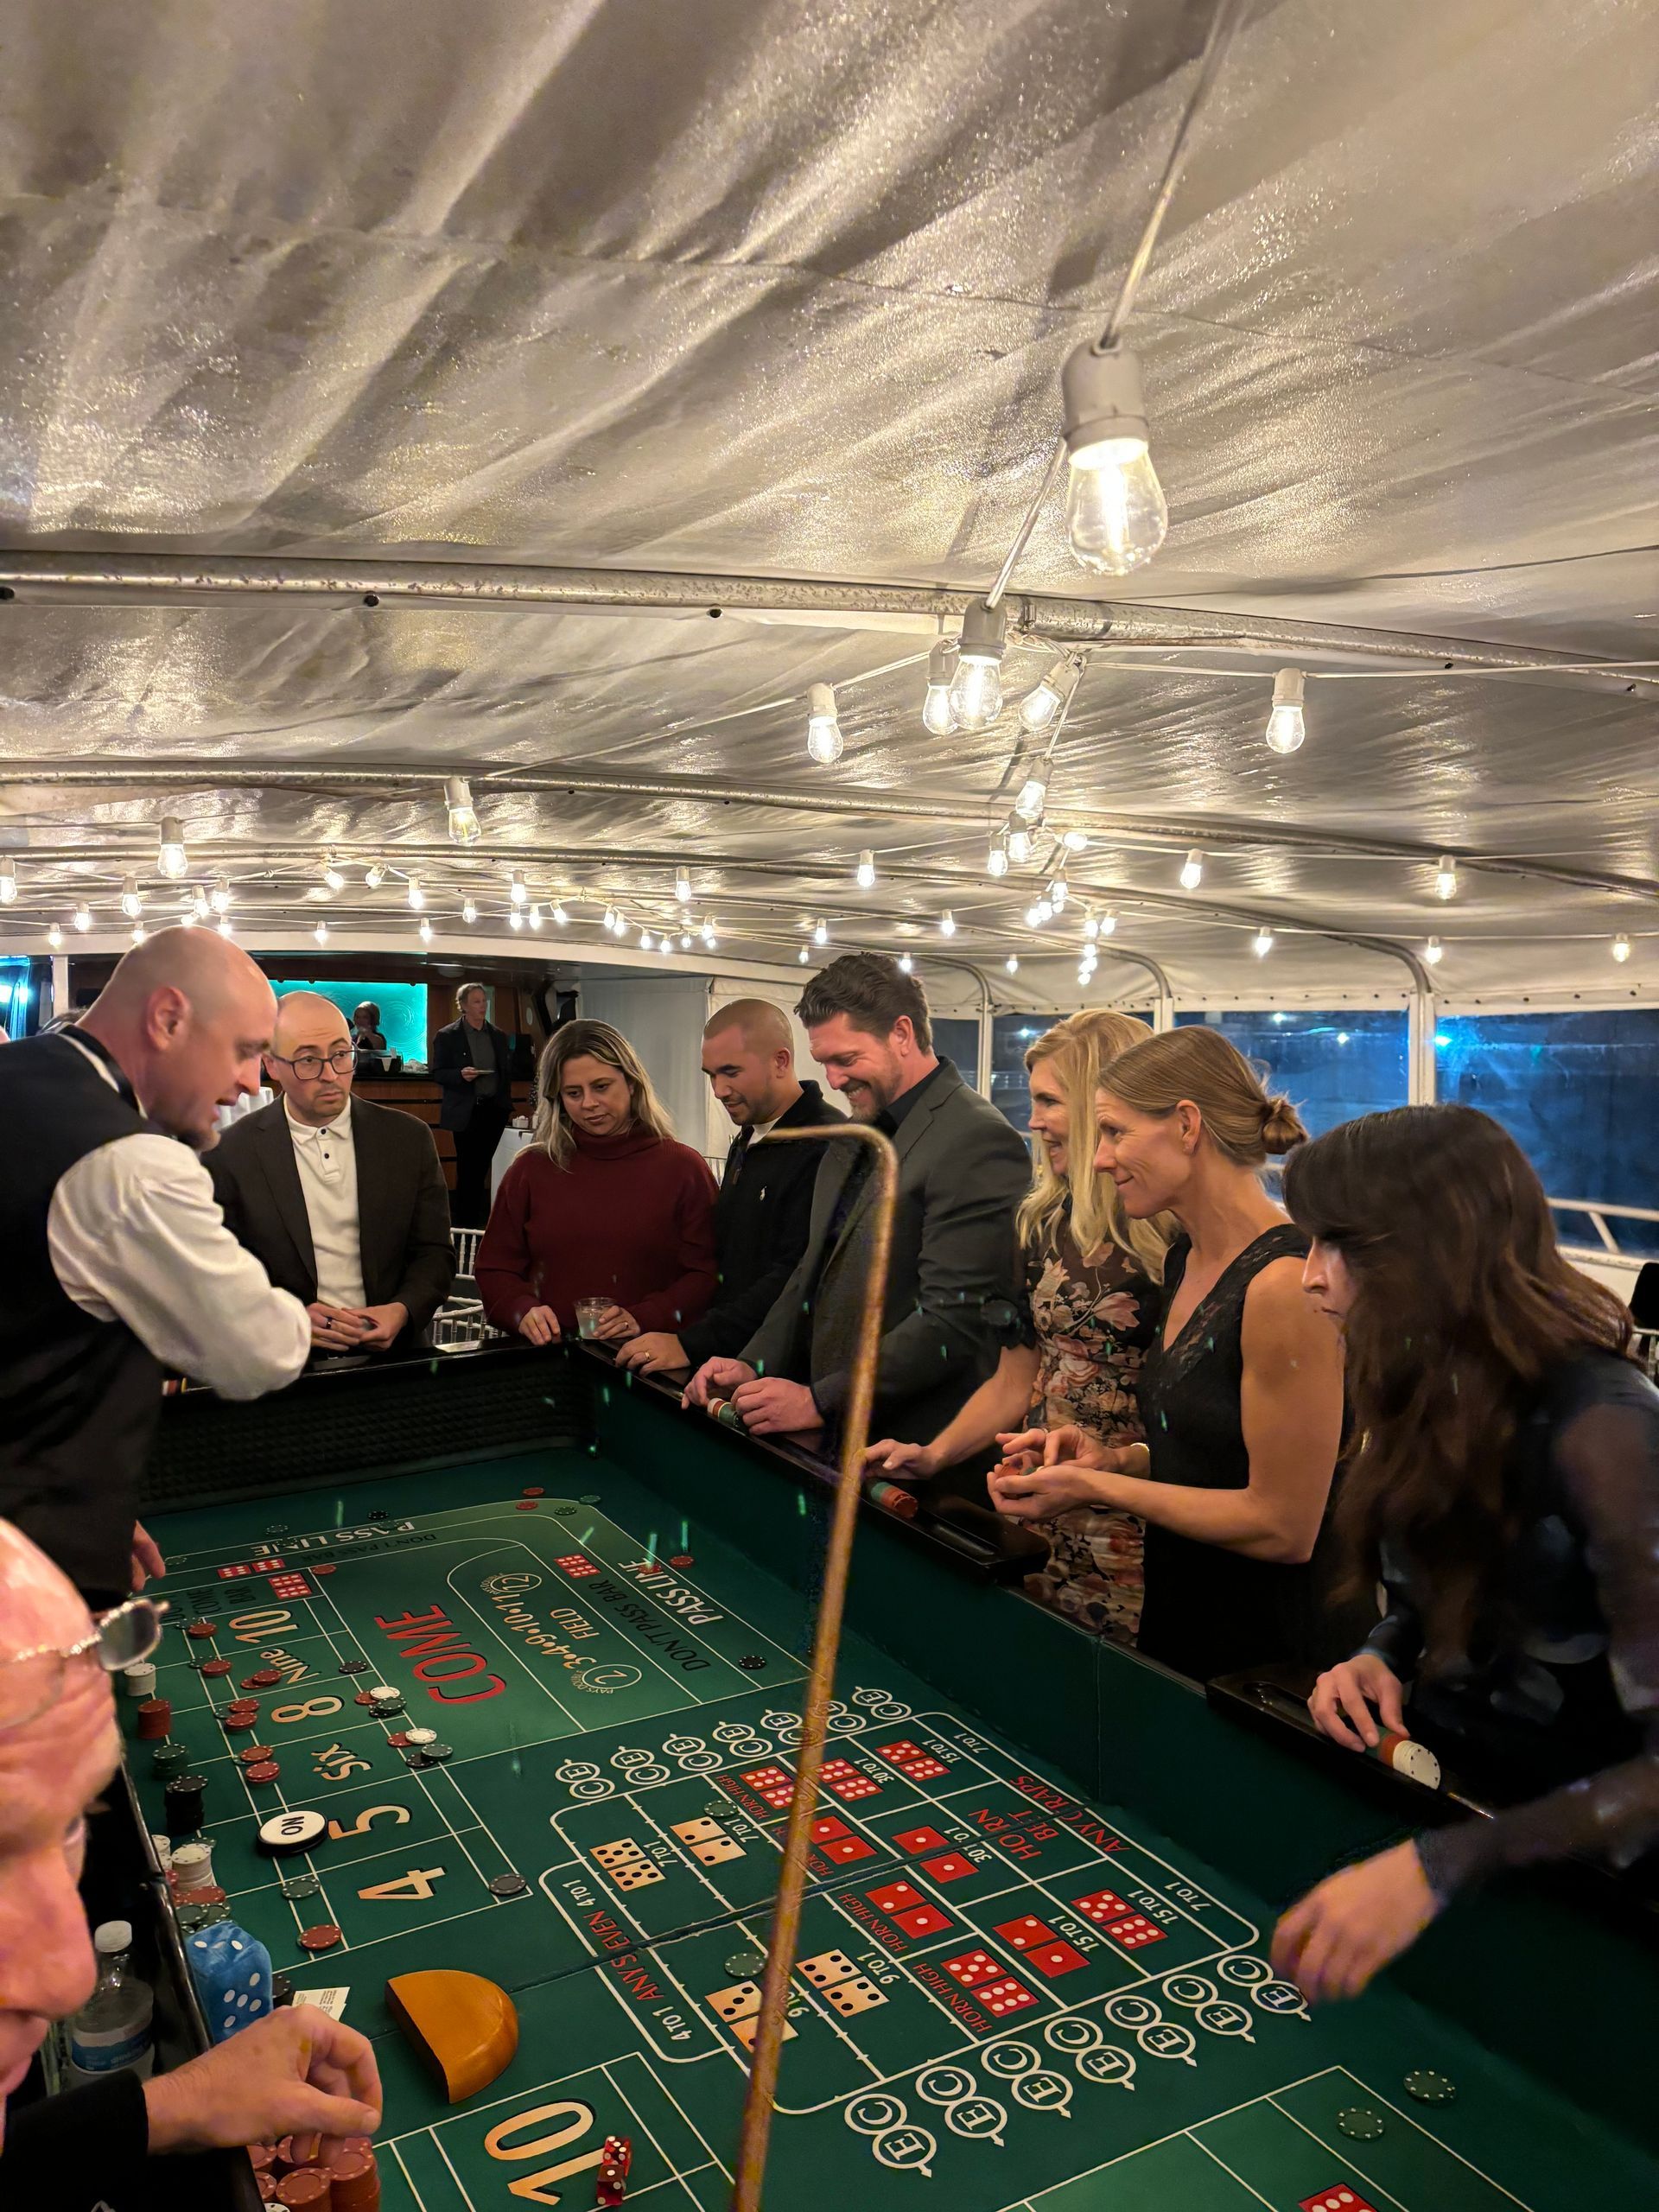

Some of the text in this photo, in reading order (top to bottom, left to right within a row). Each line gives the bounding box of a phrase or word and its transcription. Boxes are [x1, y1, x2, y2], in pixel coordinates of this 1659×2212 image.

[250, 1521, 416, 1556] PASS LINE
[501, 1575, 530, 1591] 12
[588, 1580, 628, 1603] BAR
[550, 1607, 601, 1640] FIELD
[614, 1603, 663, 1632] PASS
[656, 1588, 724, 1625] PASS
[228, 1609, 300, 1645] 10
[259, 1647, 321, 1685] Nine
[374, 1605, 506, 1704] COME
[594, 1669, 628, 1685] 2
[270, 1695, 344, 1724] 8
[768, 1715, 796, 1727] E
[860, 1692, 903, 1716] C E
[834, 1717, 857, 1728] C
[671, 1740, 713, 1768] C E
[721, 1727, 763, 1753] C E
[565, 1766, 605, 1796] C E
[620, 1753, 660, 1781] C E
[715, 1774, 771, 1819] HORN HIGH
[327, 1805, 411, 1840] 5
[1009, 1776, 1132, 1853] ANY CRAPS
[968, 1809, 1042, 1860] HORN
[968, 1848, 993, 1863] 30
[357, 1866, 446, 1900] 4
[838, 1893, 908, 1952] HORN HIGH
[1152, 1910, 1179, 1924] 15
[1190, 1903, 1211, 1911] 7
[582, 1910, 664, 2000] ANY SEVEN
[1072, 1936, 1100, 1952] 15
[880, 1974, 900, 1985] 9
[1227, 1961, 1298, 2007] C E
[787, 2007, 810, 2018] 9
[912, 1963, 993, 2033] HORN HIGH
[1173, 1981, 1243, 2029] C E
[1116, 2001, 1185, 2051] C E
[1056, 2024, 1126, 2076] C E
[993, 2048, 1063, 2102] C E
[927, 2074, 996, 2131] C E
[857, 2101, 925, 2161] C E
[484, 2099, 607, 2205] 10
